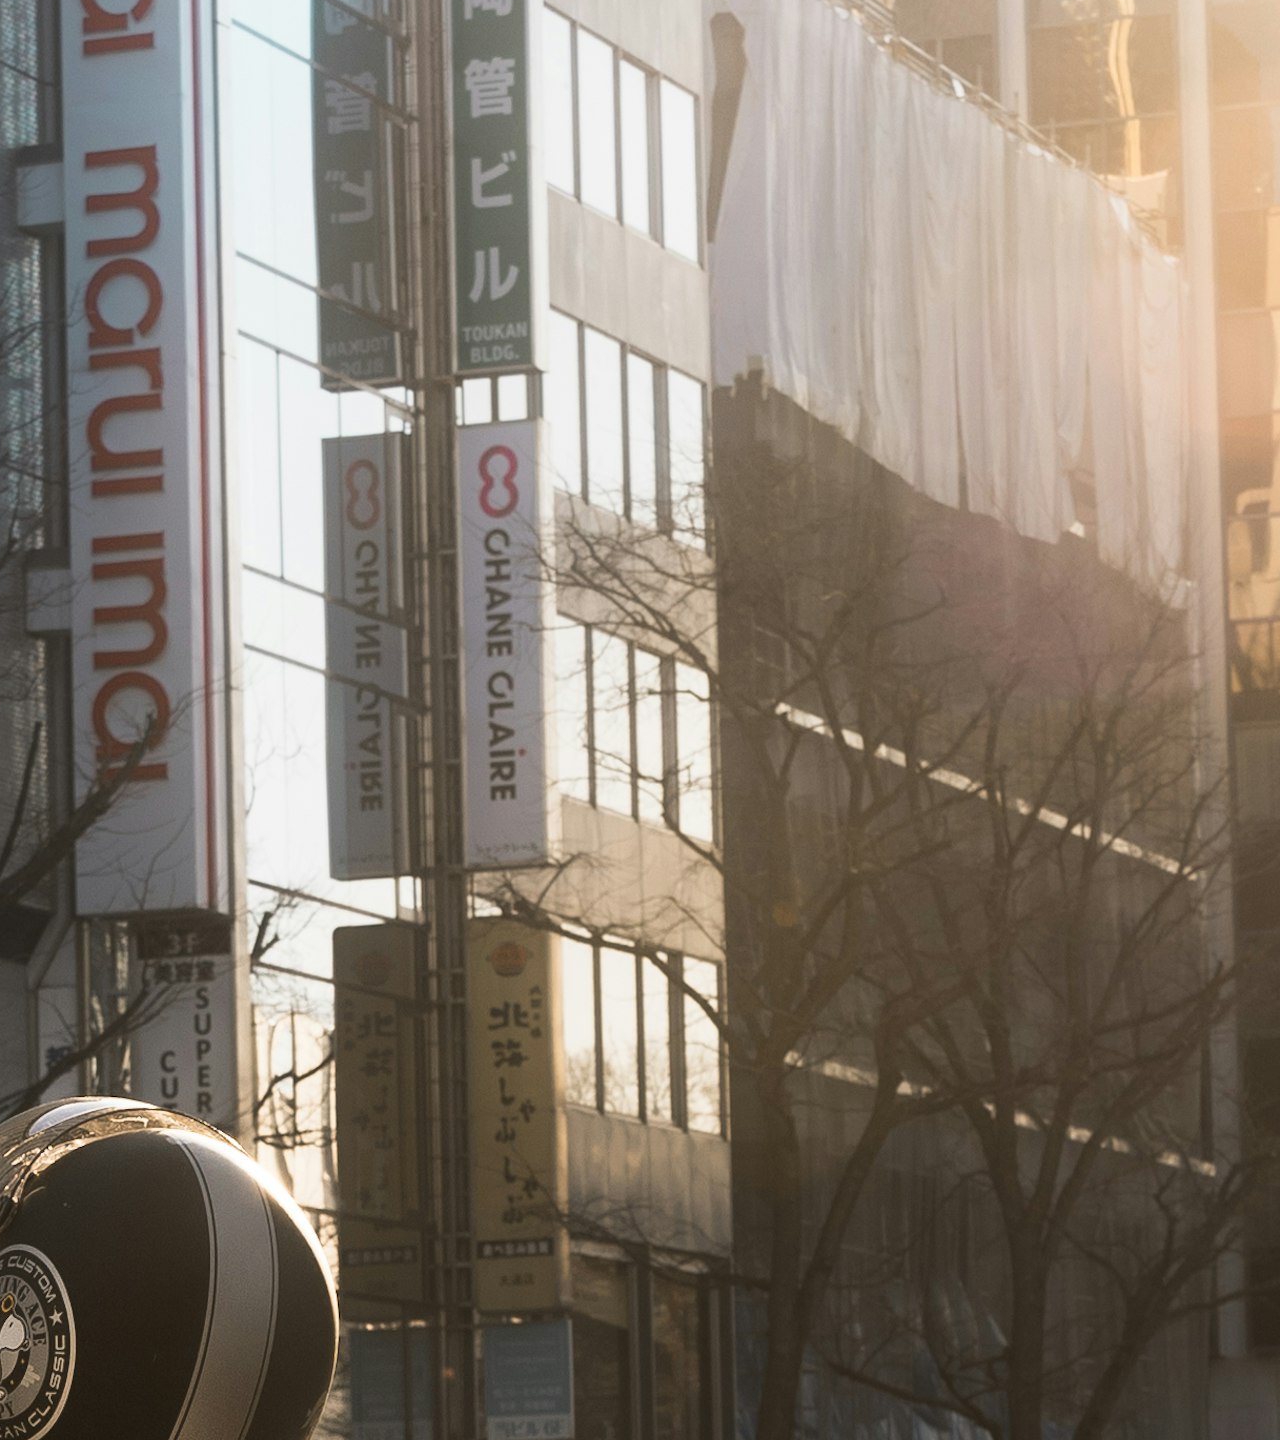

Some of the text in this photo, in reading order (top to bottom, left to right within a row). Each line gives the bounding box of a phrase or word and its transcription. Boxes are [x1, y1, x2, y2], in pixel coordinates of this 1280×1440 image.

[85, 144, 165, 498] marui
[462, 322, 528, 343] TOUKAN
[471, 346, 519, 363] BLDG.
[194, 987, 212, 1113] SUPER
[7, 1256, 57, 1304] CUSTOM
[25, 1302, 47, 1347] ACE
[27, 1334, 66, 1427] CLASSIC
